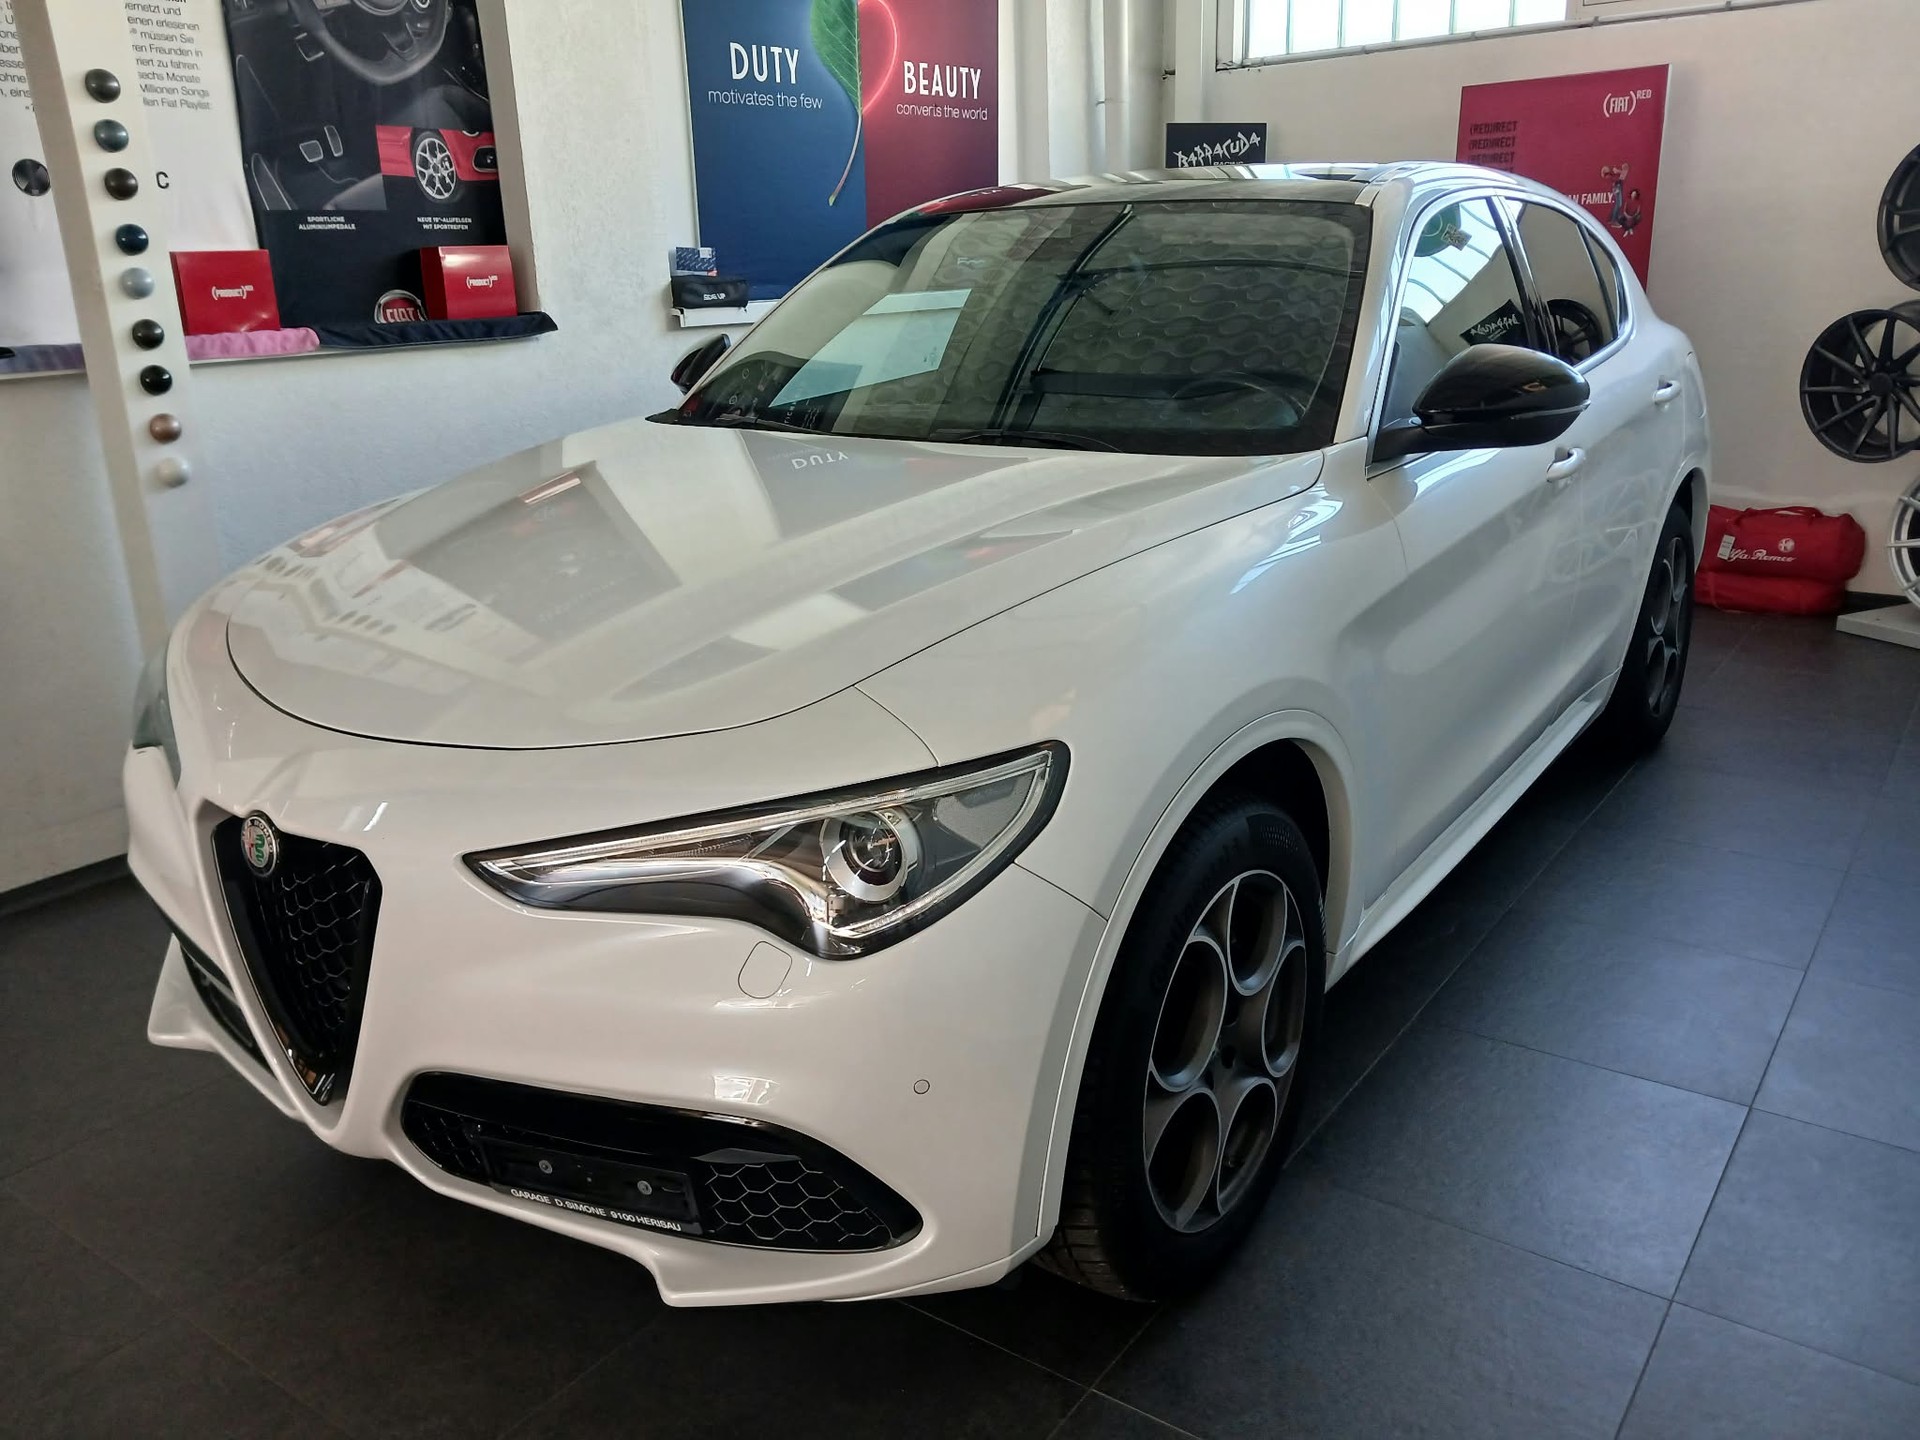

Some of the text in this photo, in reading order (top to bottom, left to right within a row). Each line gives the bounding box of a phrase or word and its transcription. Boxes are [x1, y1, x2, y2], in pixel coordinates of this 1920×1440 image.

[163, 7, 182, 16] und
[149, 43, 193, 57] Freunden
[156, 59, 169, 68] zu
[729, 41, 799, 85] DUTY
[903, 60, 982, 100] BEAUTY
[708, 88, 823, 109] motivates the few
[943, 104, 961, 119] the
[961, 106, 989, 121] world
[1172, 130, 1262, 168] BARRACUDA
[1581, 191, 1616, 206] FAMILY.
[1751, 549, 1799, 563] Romeo
[510, 1188, 682, 1232] GARAGE D.SIMONE 9100 HERISAU
